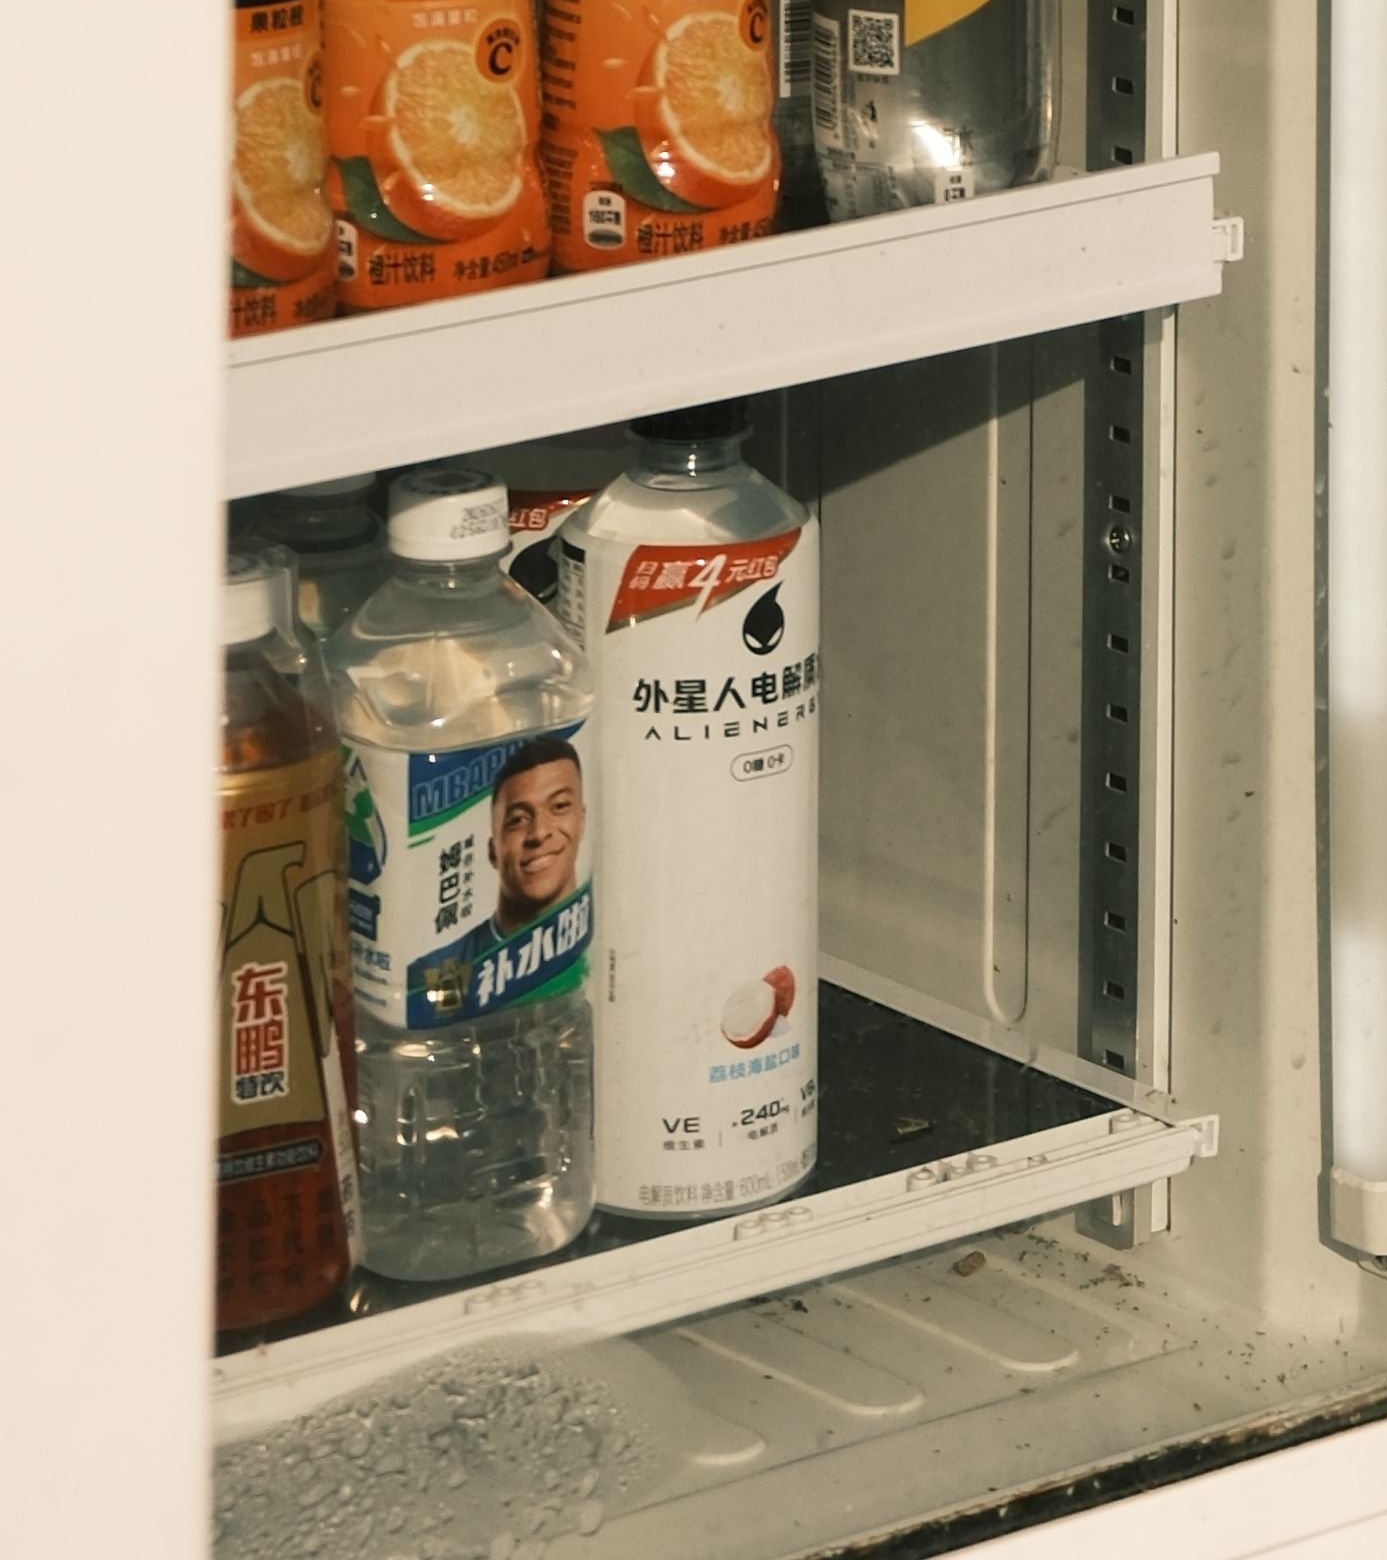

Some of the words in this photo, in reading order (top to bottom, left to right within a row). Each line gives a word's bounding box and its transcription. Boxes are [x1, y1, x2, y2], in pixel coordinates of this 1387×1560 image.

[476, 898, 589, 1008] 补水啦
[232, 960, 288, 1079] 东鹏
[235, 1070, 288, 1105] 特饮
[662, 1117, 700, 1133] VE
